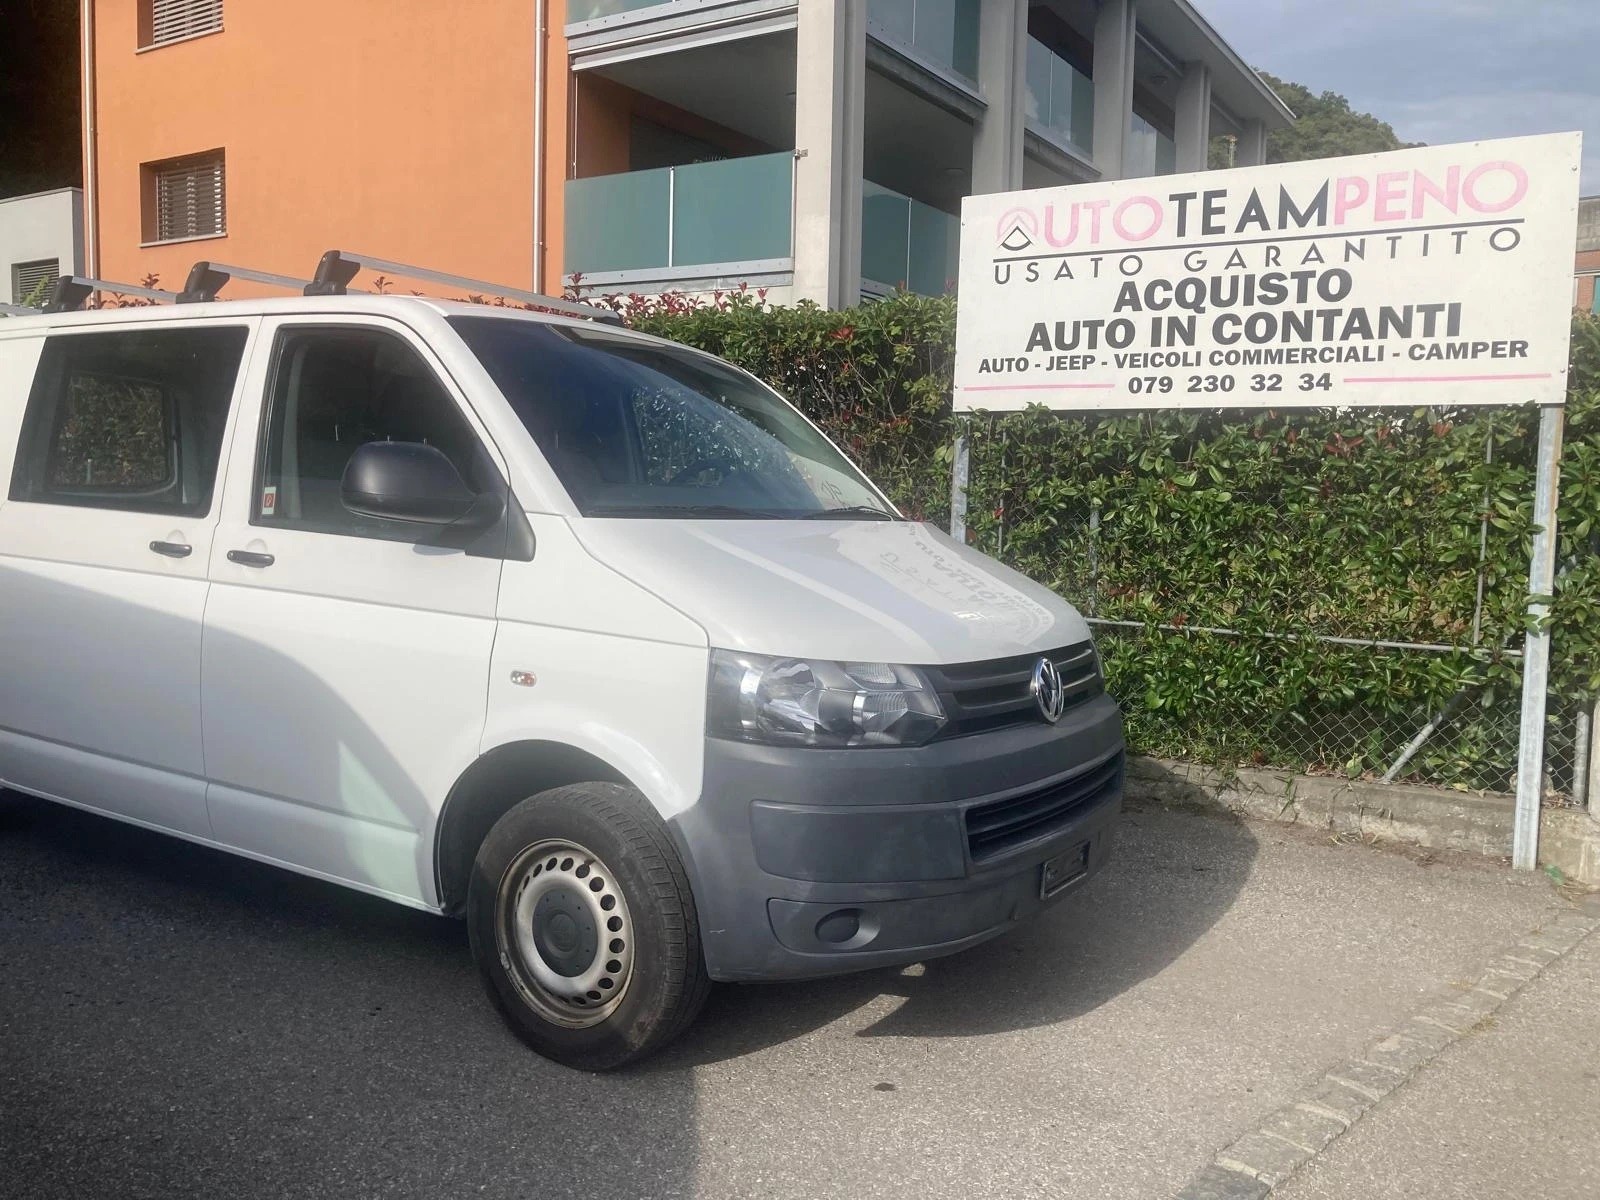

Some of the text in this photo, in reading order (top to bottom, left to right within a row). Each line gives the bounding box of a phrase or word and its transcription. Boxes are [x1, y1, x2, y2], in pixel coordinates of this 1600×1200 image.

[995, 226, 1521, 285] USATO GARANTITO
[1113, 267, 1353, 314] ACQUISTO
[1025, 302, 1462, 352] AUTO IN CONTANTI
[978, 357, 1030, 374] AUTO
[1046, 353, 1096, 372] JEEP
[1114, 350, 1202, 369] VEICOLI
[1208, 344, 1385, 367] COMMERCIALI
[1408, 339, 1529, 361] CAMPER
[1127, 372, 1333, 394] 079 230 32 34
